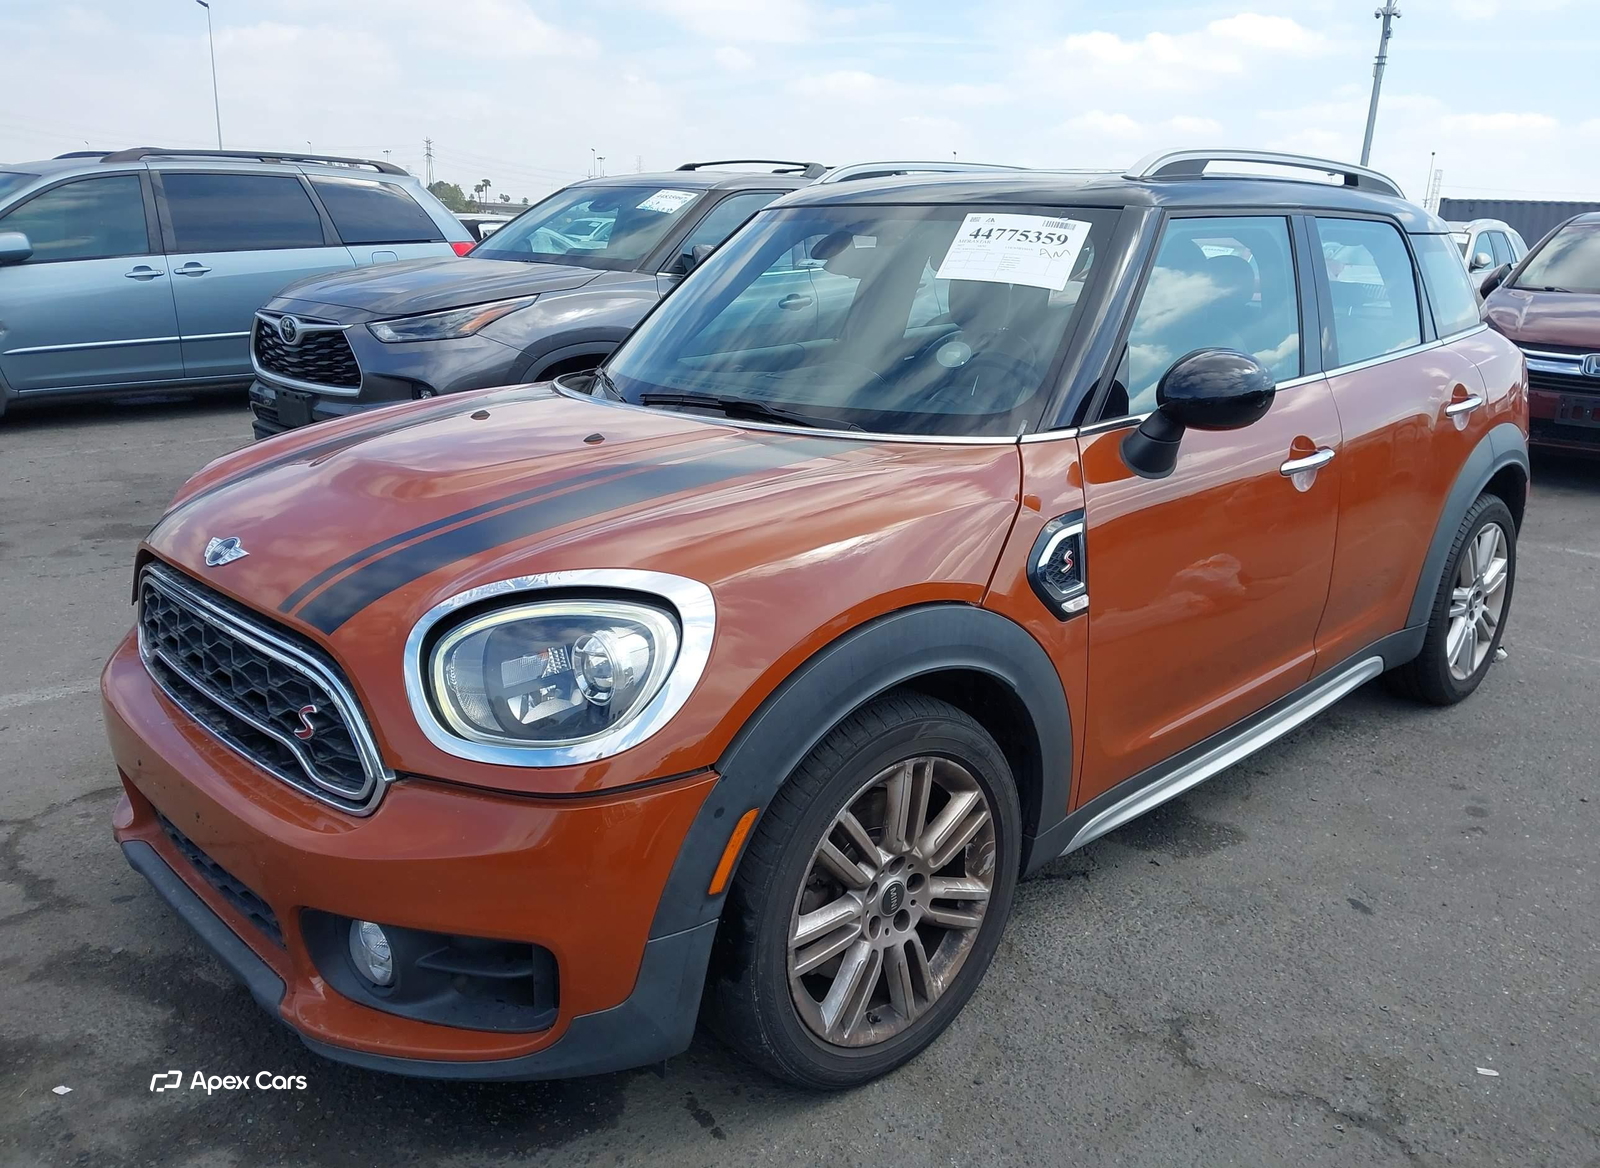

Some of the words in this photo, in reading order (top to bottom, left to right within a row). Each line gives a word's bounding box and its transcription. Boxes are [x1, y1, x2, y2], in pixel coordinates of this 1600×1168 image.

[968, 227, 1069, 246] 44775359
[1061, 550, 1073, 574] S
[294, 704, 317, 740] S
[890, 887, 898, 911] MINI
